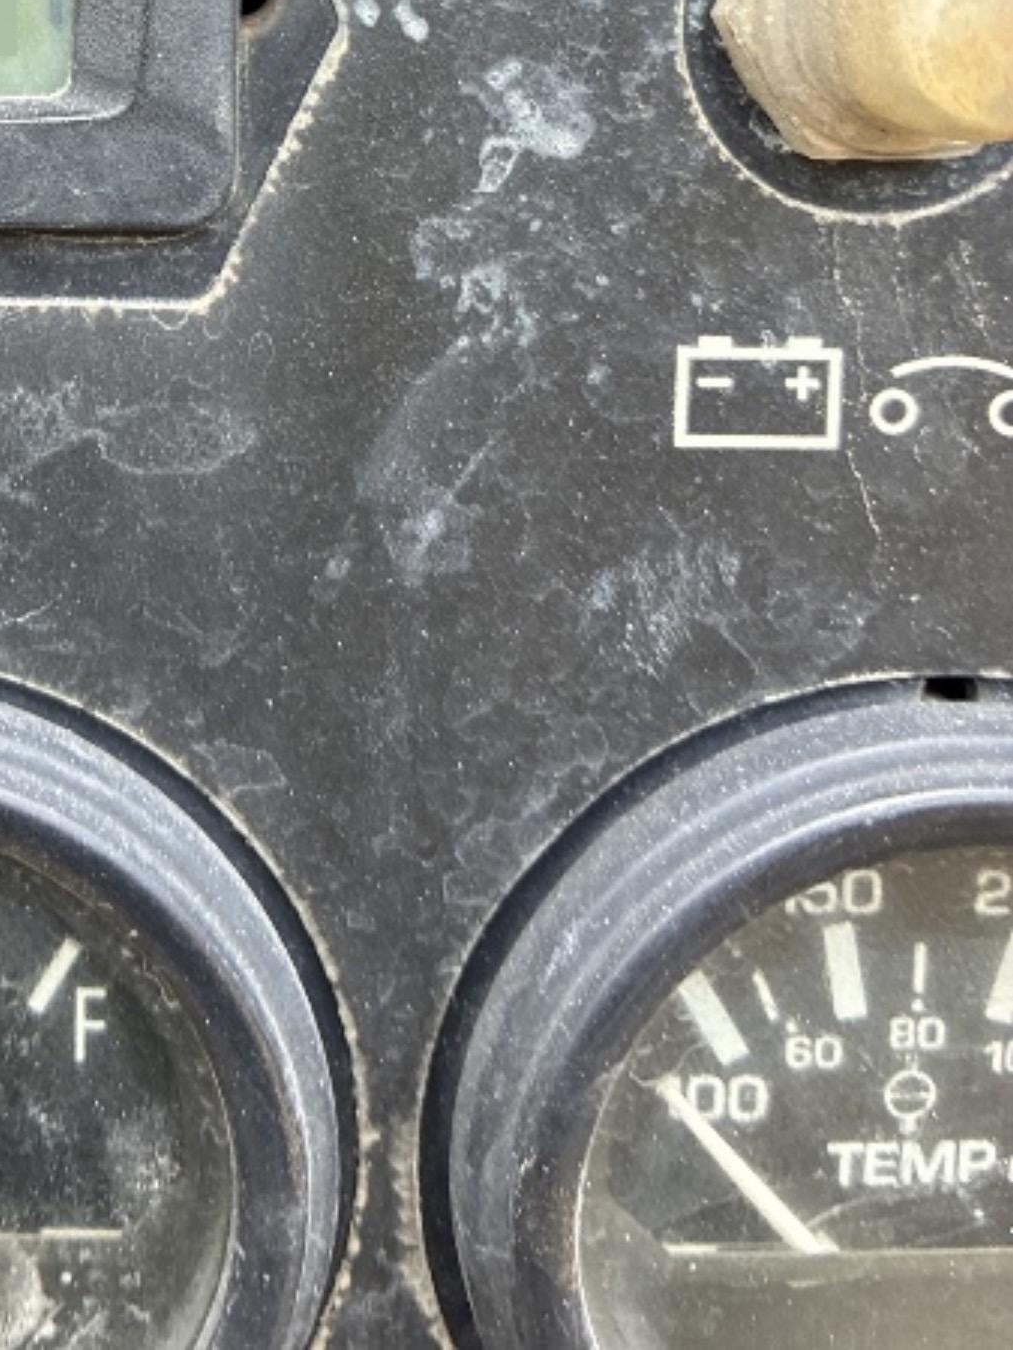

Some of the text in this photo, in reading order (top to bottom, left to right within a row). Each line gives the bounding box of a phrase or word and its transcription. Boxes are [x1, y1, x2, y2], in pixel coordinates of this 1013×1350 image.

[74, 987, 107, 1062] F
[889, 1016, 946, 1051] 80
[785, 1035, 843, 1070] 60
[827, 1139, 997, 1187] TEMP
